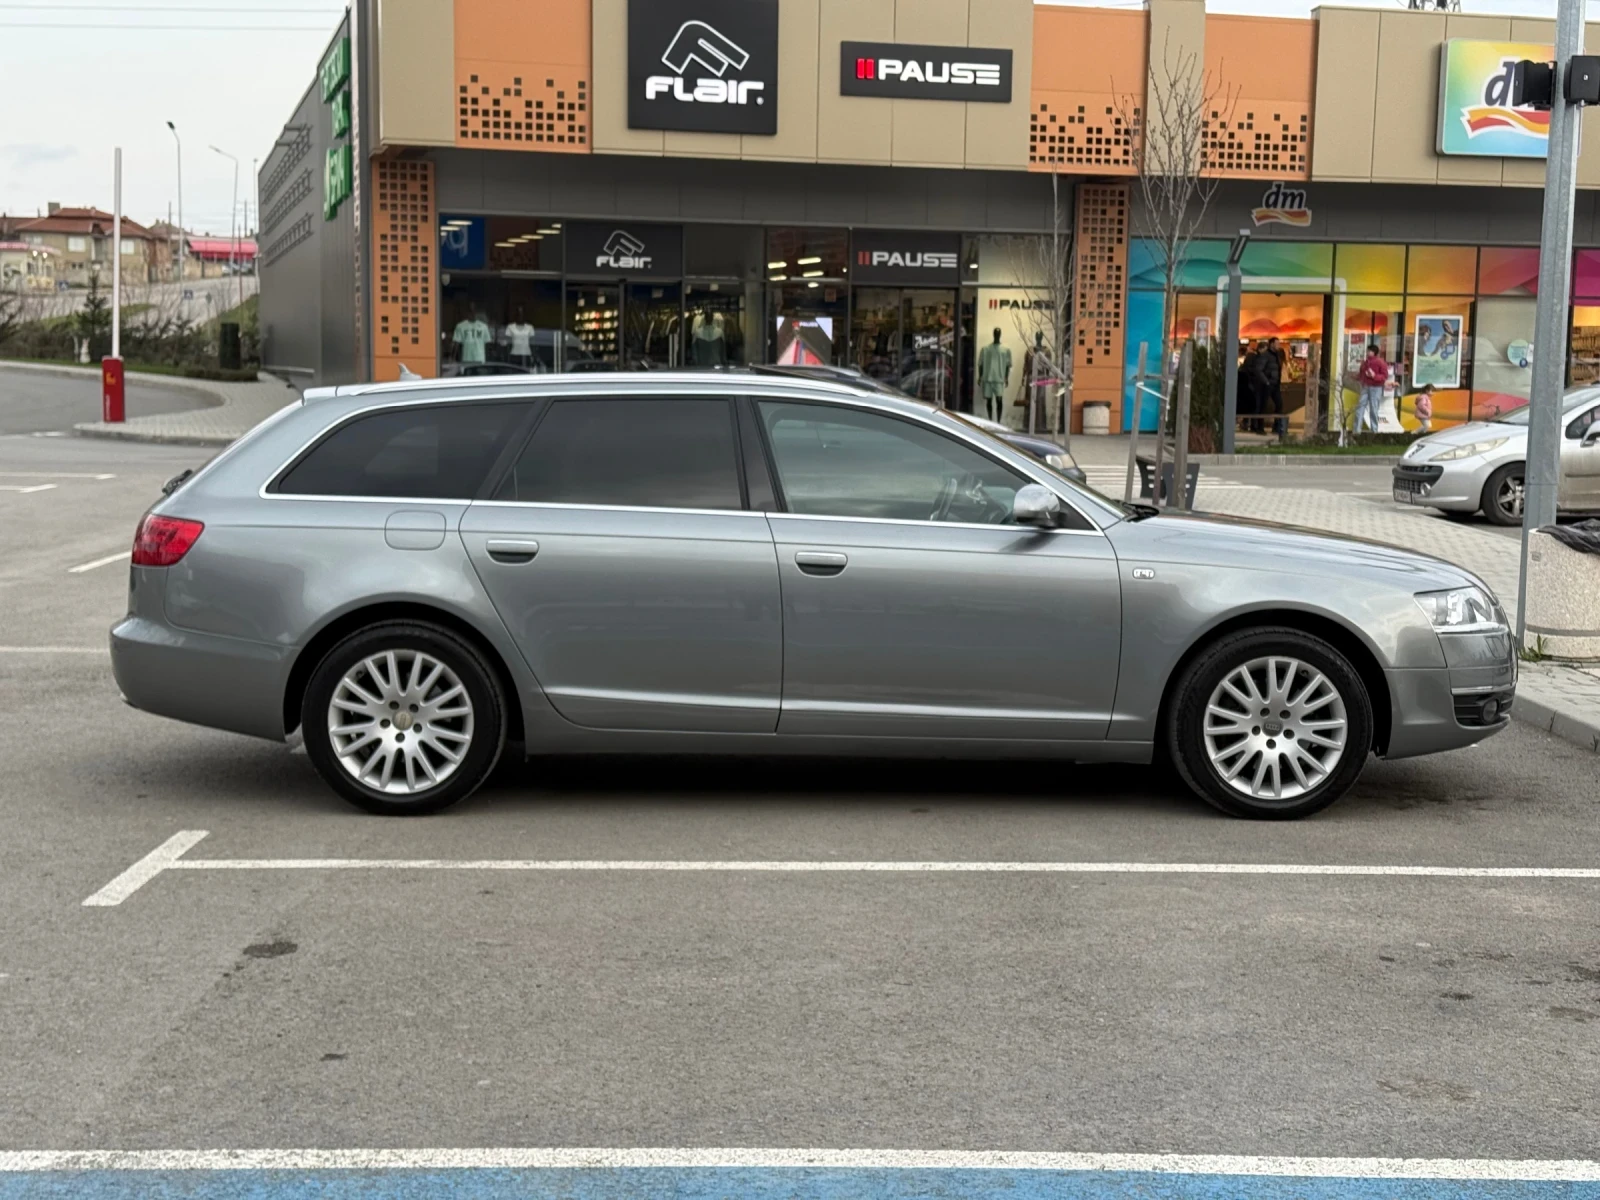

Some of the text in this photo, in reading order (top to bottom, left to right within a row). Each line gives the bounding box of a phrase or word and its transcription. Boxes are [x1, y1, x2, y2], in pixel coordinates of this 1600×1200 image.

[878, 59, 1001, 85] PAUSE
[1265, 183, 1305, 209] dm
[872, 251, 957, 268] PAUSE
